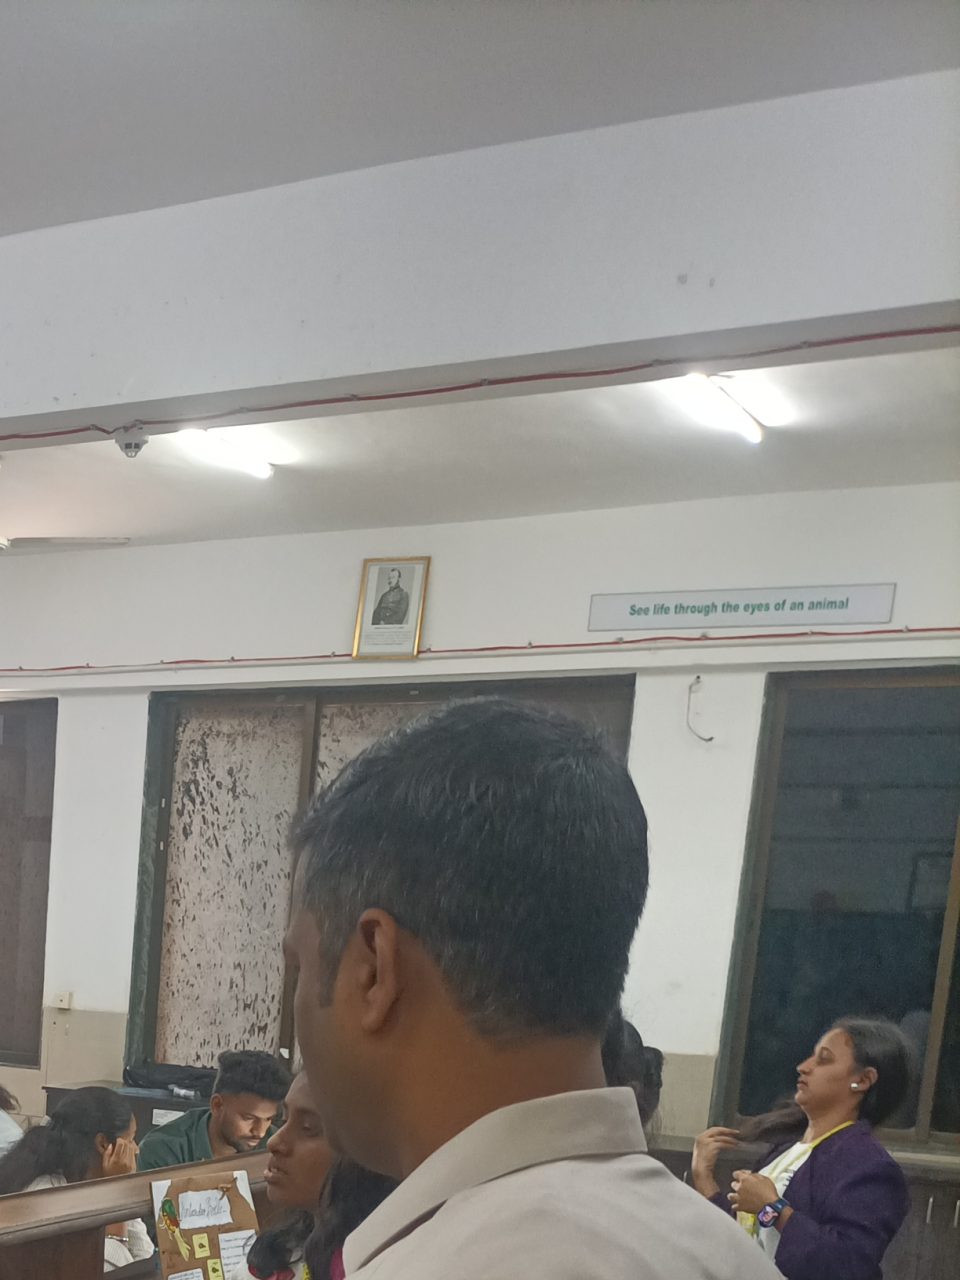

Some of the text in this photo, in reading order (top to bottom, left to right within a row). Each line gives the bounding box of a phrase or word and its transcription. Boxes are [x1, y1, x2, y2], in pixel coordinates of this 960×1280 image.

[629, 597, 849, 617] See life through the eyes of an animal
